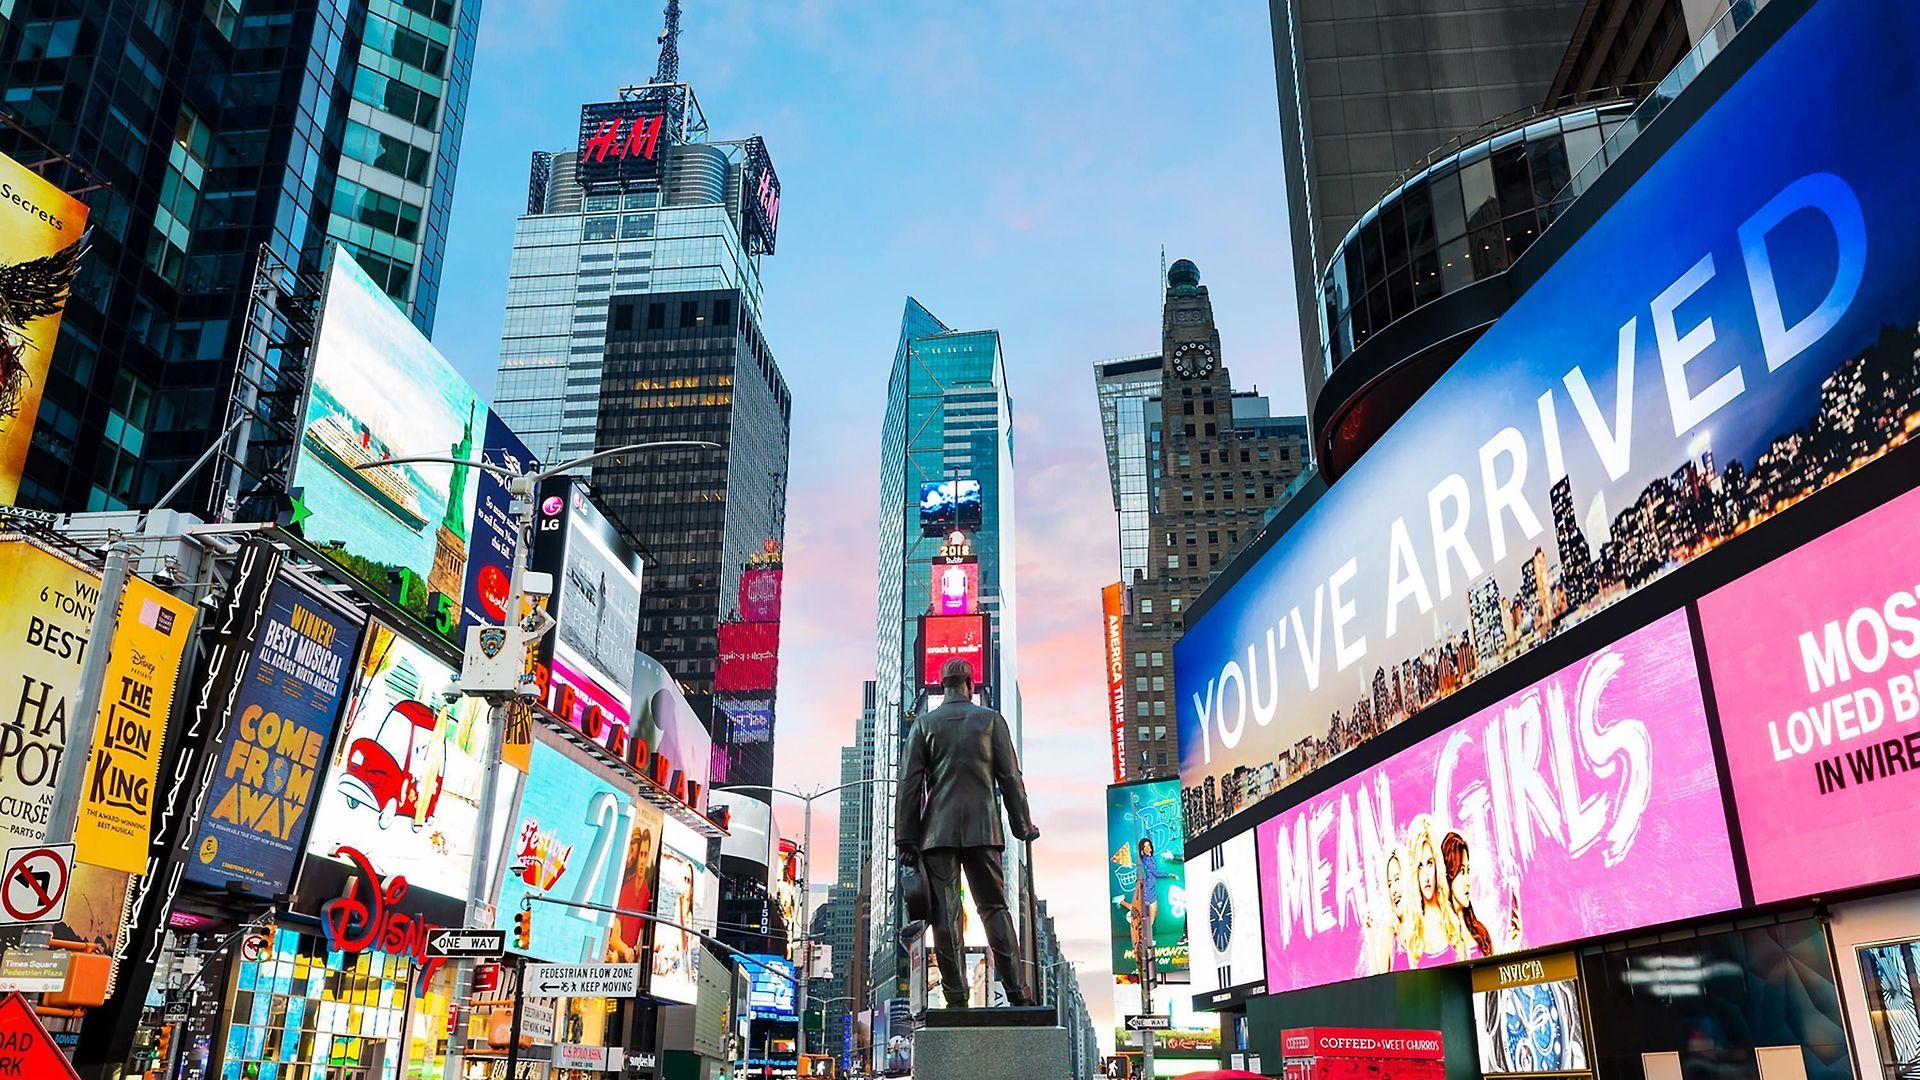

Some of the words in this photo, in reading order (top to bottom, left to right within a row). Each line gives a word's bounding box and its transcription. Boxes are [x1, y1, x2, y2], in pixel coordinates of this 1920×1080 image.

[583, 114, 664, 163] H&M
[1, 182, 63, 231] Secrets
[1192, 557, 1377, 765] YOU'VE
[1384, 173, 1867, 638] ARRIVED
[0, 506, 54, 520] AMAR
[541, 519, 562, 530] LG
[941, 546, 970, 556] 2018
[40, 586, 49, 602] 6
[54, 590, 96, 623] TONY
[26, 615, 88, 665] BEST
[291, 603, 336, 649] WINNER!
[1797, 585, 1920, 694] MOS
[264, 619, 298, 657] BEST
[294, 635, 342, 684] MUSICAL
[958, 645, 979, 653] smile
[1108, 614, 1123, 683] AMERICA
[259, 646, 272, 663] ALL
[271, 652, 296, 675] ACROSS
[295, 664, 314, 685] NORTH
[313, 675, 338, 697] AMERICA
[12, 674, 66, 745] HA
[121, 675, 153, 710] THE
[1114, 685, 1124, 724] TIME
[104, 703, 152, 753] LION
[240, 704, 324, 769] COME
[534, 665, 702, 808] BROADWAY
[1768, 687, 1884, 761] LOVED
[0, 722, 64, 788] POT
[1814, 756, 1848, 795] IN
[1845, 736, 1920, 784] WIRE
[89, 749, 149, 806] KING
[0, 796, 49, 825] CURSE
[39, 793, 54, 806] AN
[87, 808, 98, 817] THE
[210, 782, 305, 841] AWAY
[1276, 766, 1403, 949] MEAN
[1431, 650, 1653, 882] GIRLS
[10, 824, 34, 838] PARTS
[97, 821, 109, 831] BEST
[322, 846, 449, 998] Disn
[760, 901, 769, 935] 1500
[439, 937, 460, 949] ONE
[471, 937, 495, 949] WAY
[5, 960, 29, 968] Times
[30, 960, 58, 971] Square
[540, 968, 588, 981] PEDESTRIAN
[589, 968, 612, 981] FLOW
[613, 968, 633, 981] ZONE
[1499, 960, 1545, 984] INVICTA
[580, 982, 601, 993] KEEP
[602, 982, 632, 993] MOVING
[0, 1032, 33, 1051] AD
[1319, 1037, 1377, 1049] COFFEED
[1381, 1039, 1405, 1050] SWEET
[1406, 1040, 1440, 1051] CHURROS
[0, 1057, 25, 1077] RK
